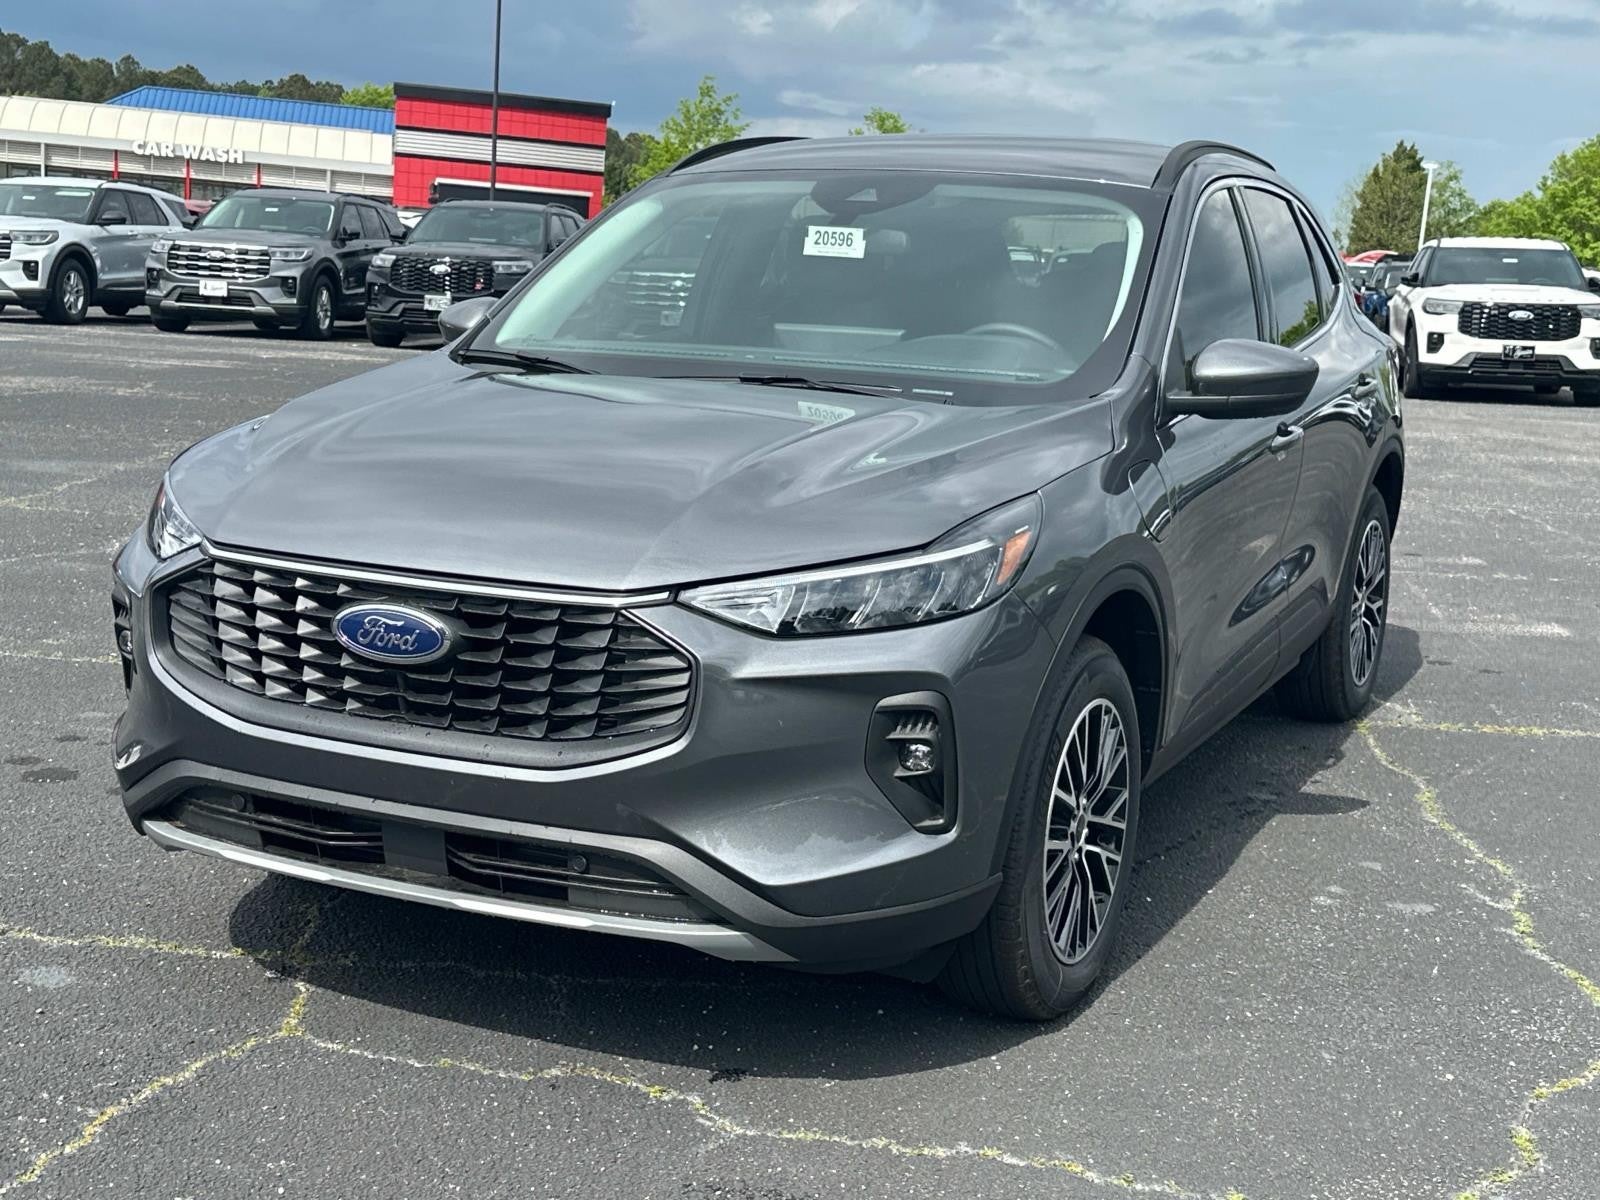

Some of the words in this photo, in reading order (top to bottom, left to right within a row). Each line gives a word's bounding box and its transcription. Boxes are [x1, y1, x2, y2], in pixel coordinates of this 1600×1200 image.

[132, 140, 174, 158] CAR
[181, 143, 244, 164] WASH
[814, 230, 854, 247] 20596
[357, 615, 419, 650] Ford
